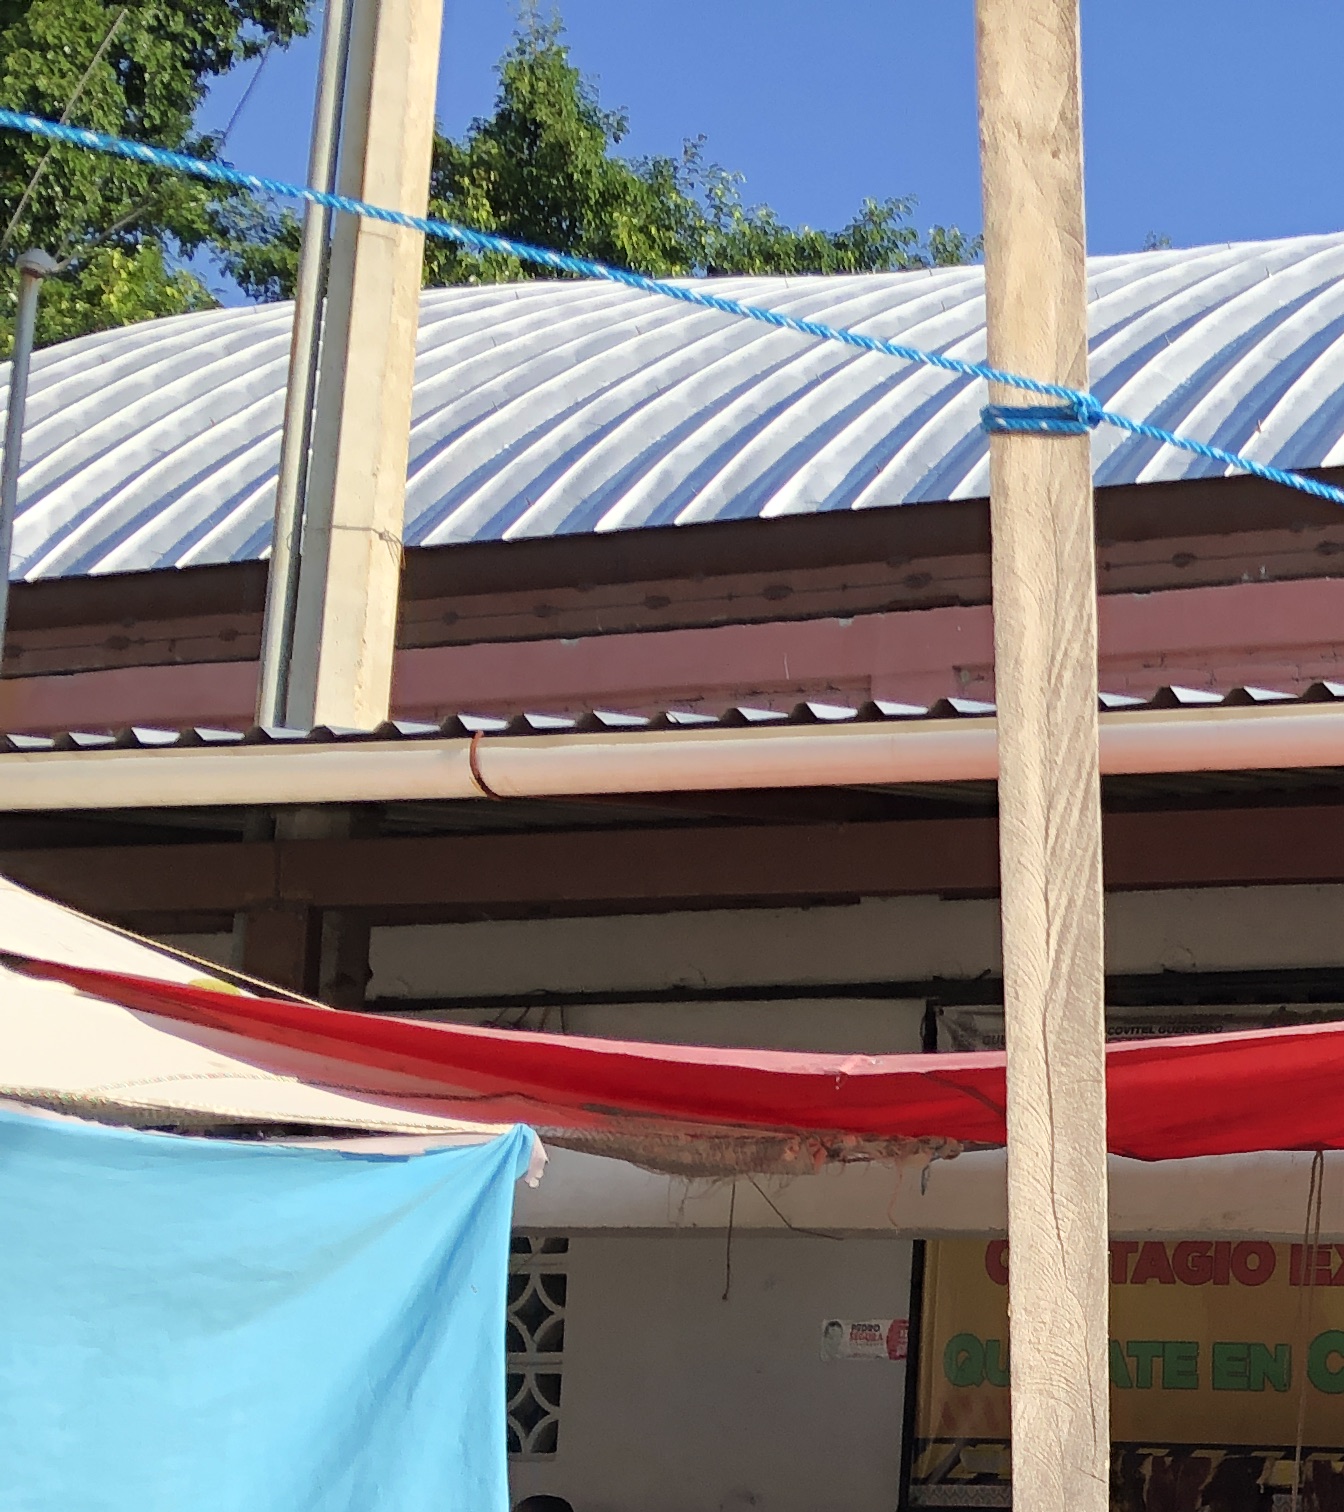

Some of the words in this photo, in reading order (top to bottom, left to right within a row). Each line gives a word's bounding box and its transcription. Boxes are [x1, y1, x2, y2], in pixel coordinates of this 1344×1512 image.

[985, 1240, 1276, 1287] CTAGIO
[943, 1332, 1199, 1390] QUATE
[1212, 1339, 1292, 1392] EN
